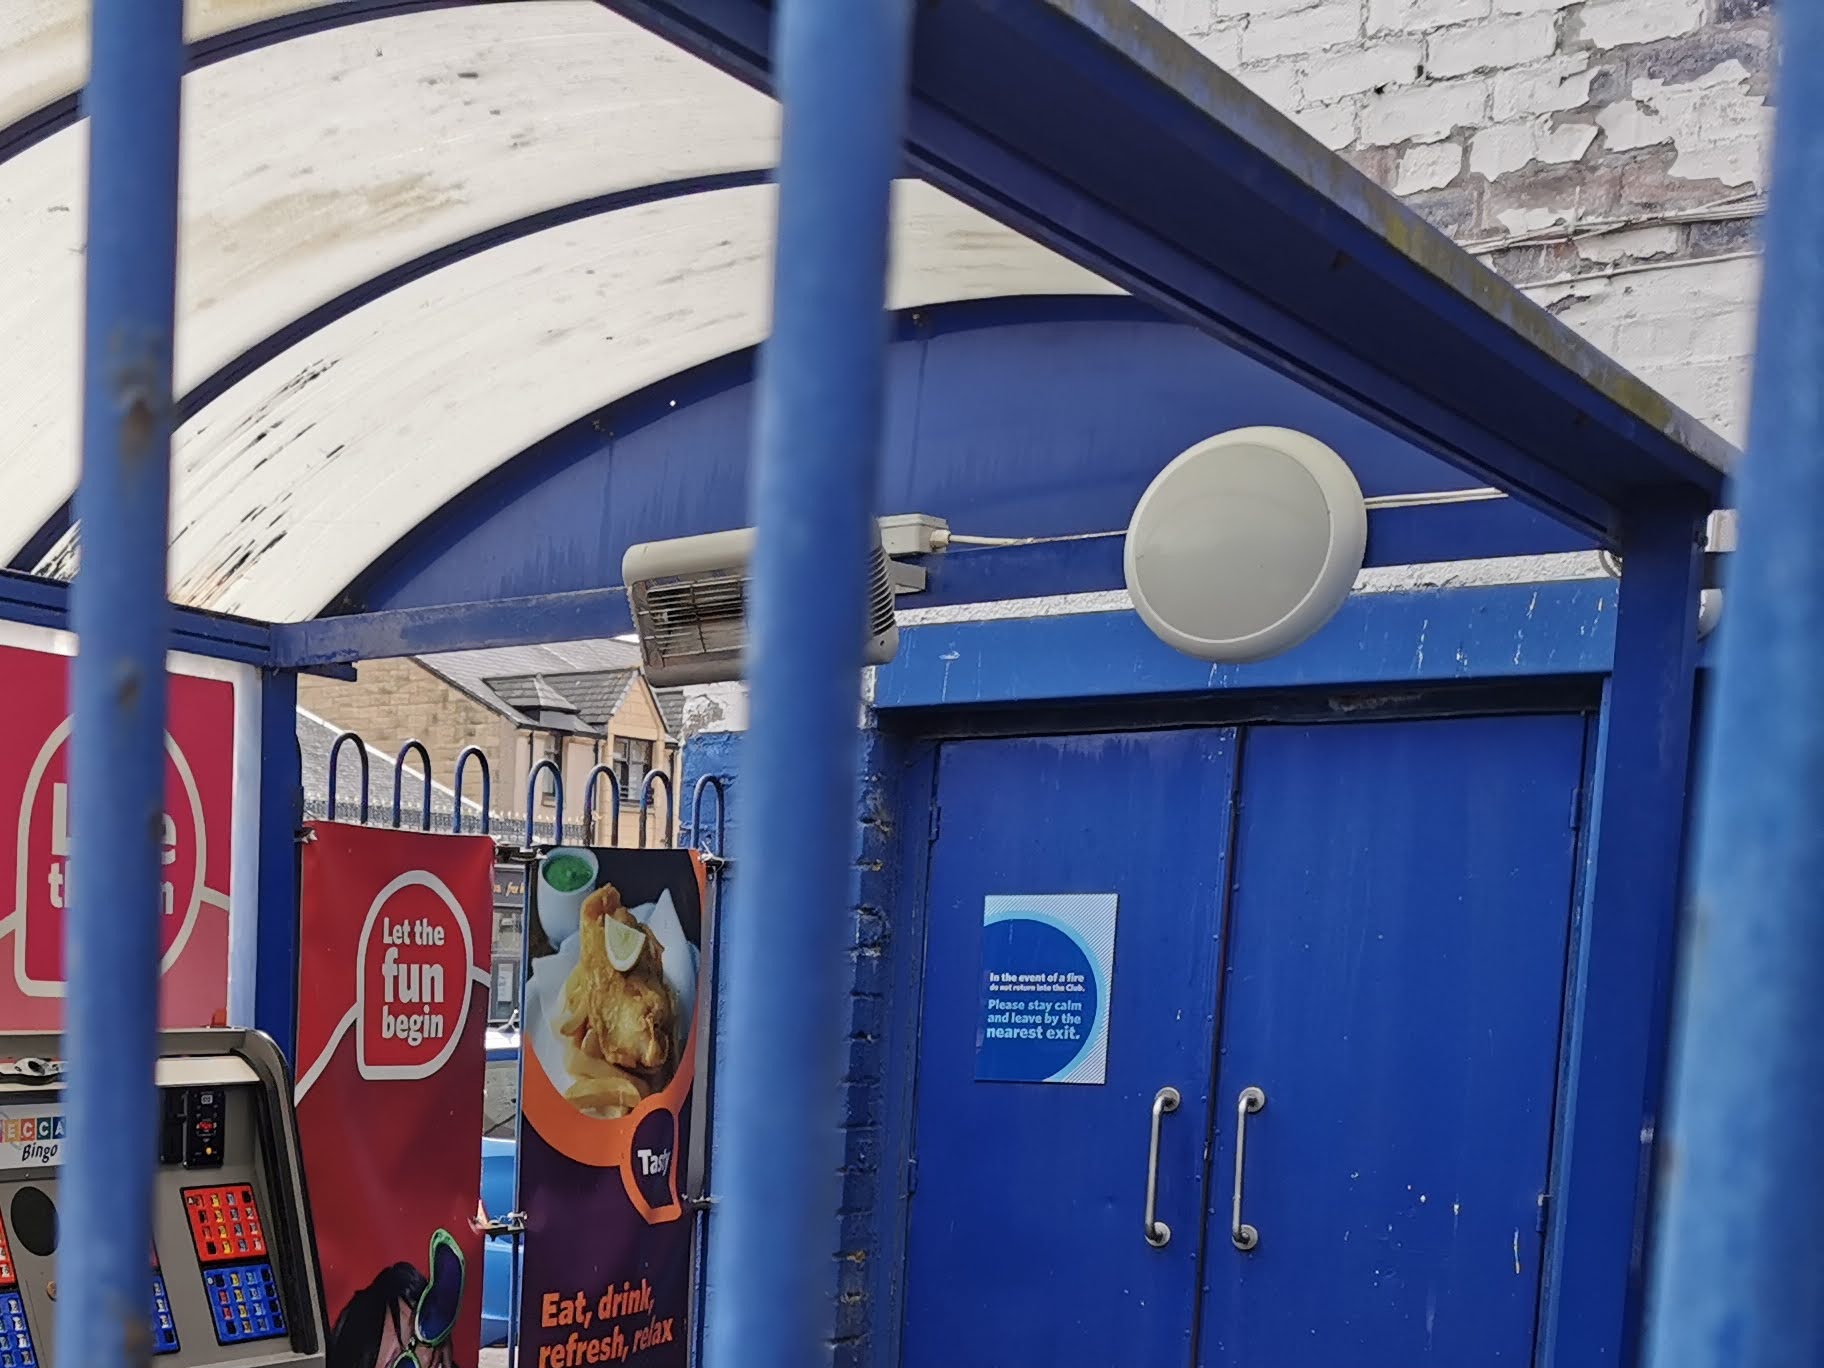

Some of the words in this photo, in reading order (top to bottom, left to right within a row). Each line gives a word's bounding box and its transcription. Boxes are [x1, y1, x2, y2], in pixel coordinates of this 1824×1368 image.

[383, 917, 411, 945] Let
[414, 918, 445, 946] the
[382, 947, 444, 1003] fun
[989, 972, 1000, 982] In
[1001, 972, 1017, 982] the
[1018, 973, 1046, 982] event
[1047, 972, 1059, 982] of
[1066, 972, 1085, 983] fire
[989, 983, 999, 991] do
[1036, 983, 1051, 991] into
[1052, 984, 1065, 992] the
[988, 998, 1025, 1010] Please
[1027, 1000, 1053, 1012] stay
[1054, 1000, 1082, 1011] calm
[382, 1005, 444, 1047] begin
[987, 1012, 1010, 1023] and
[1011, 1012, 1042, 1023] leave
[1044, 1012, 1059, 1026] by
[1061, 1013, 1081, 1024] the
[986, 1025, 1043, 1039] nearest
[1045, 1025, 1081, 1040] exit.
[21, 1142, 58, 1163] Bingo
[541, 1291, 593, 1329] Eat,
[597, 1278, 655, 1321] drink,
[632, 1315, 674, 1353] relax
